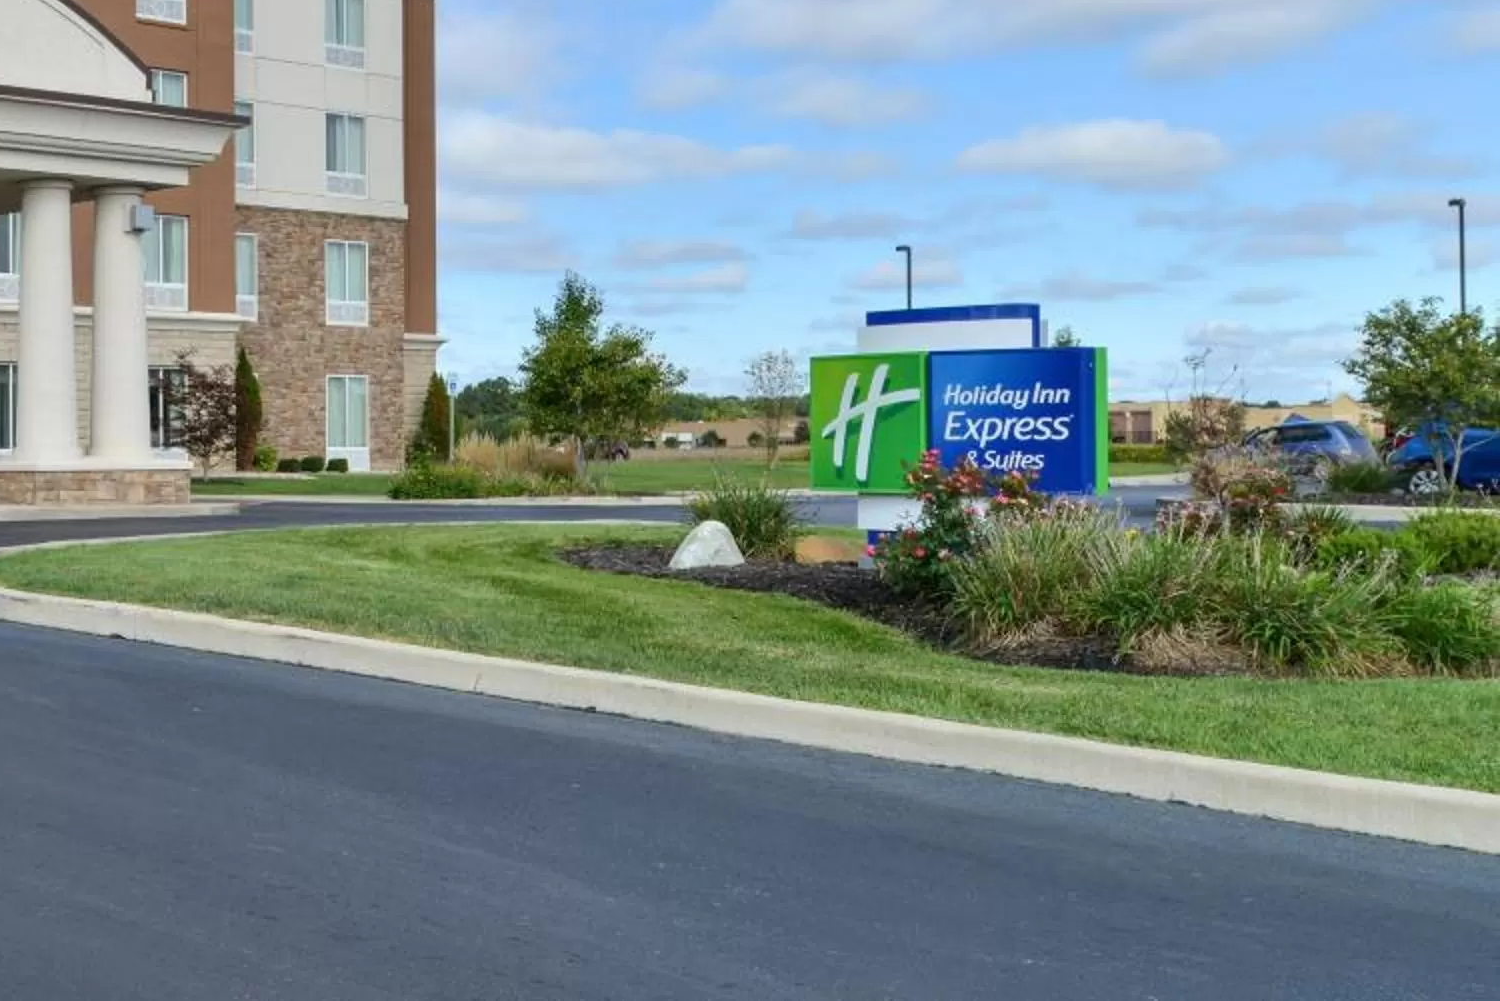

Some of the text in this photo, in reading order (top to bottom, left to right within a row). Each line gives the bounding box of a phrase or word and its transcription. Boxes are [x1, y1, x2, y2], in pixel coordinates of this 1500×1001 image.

[943, 382, 1071, 410] Holiday Inn
[943, 411, 1071, 448] Express
[966, 450, 1045, 474] & Suites
